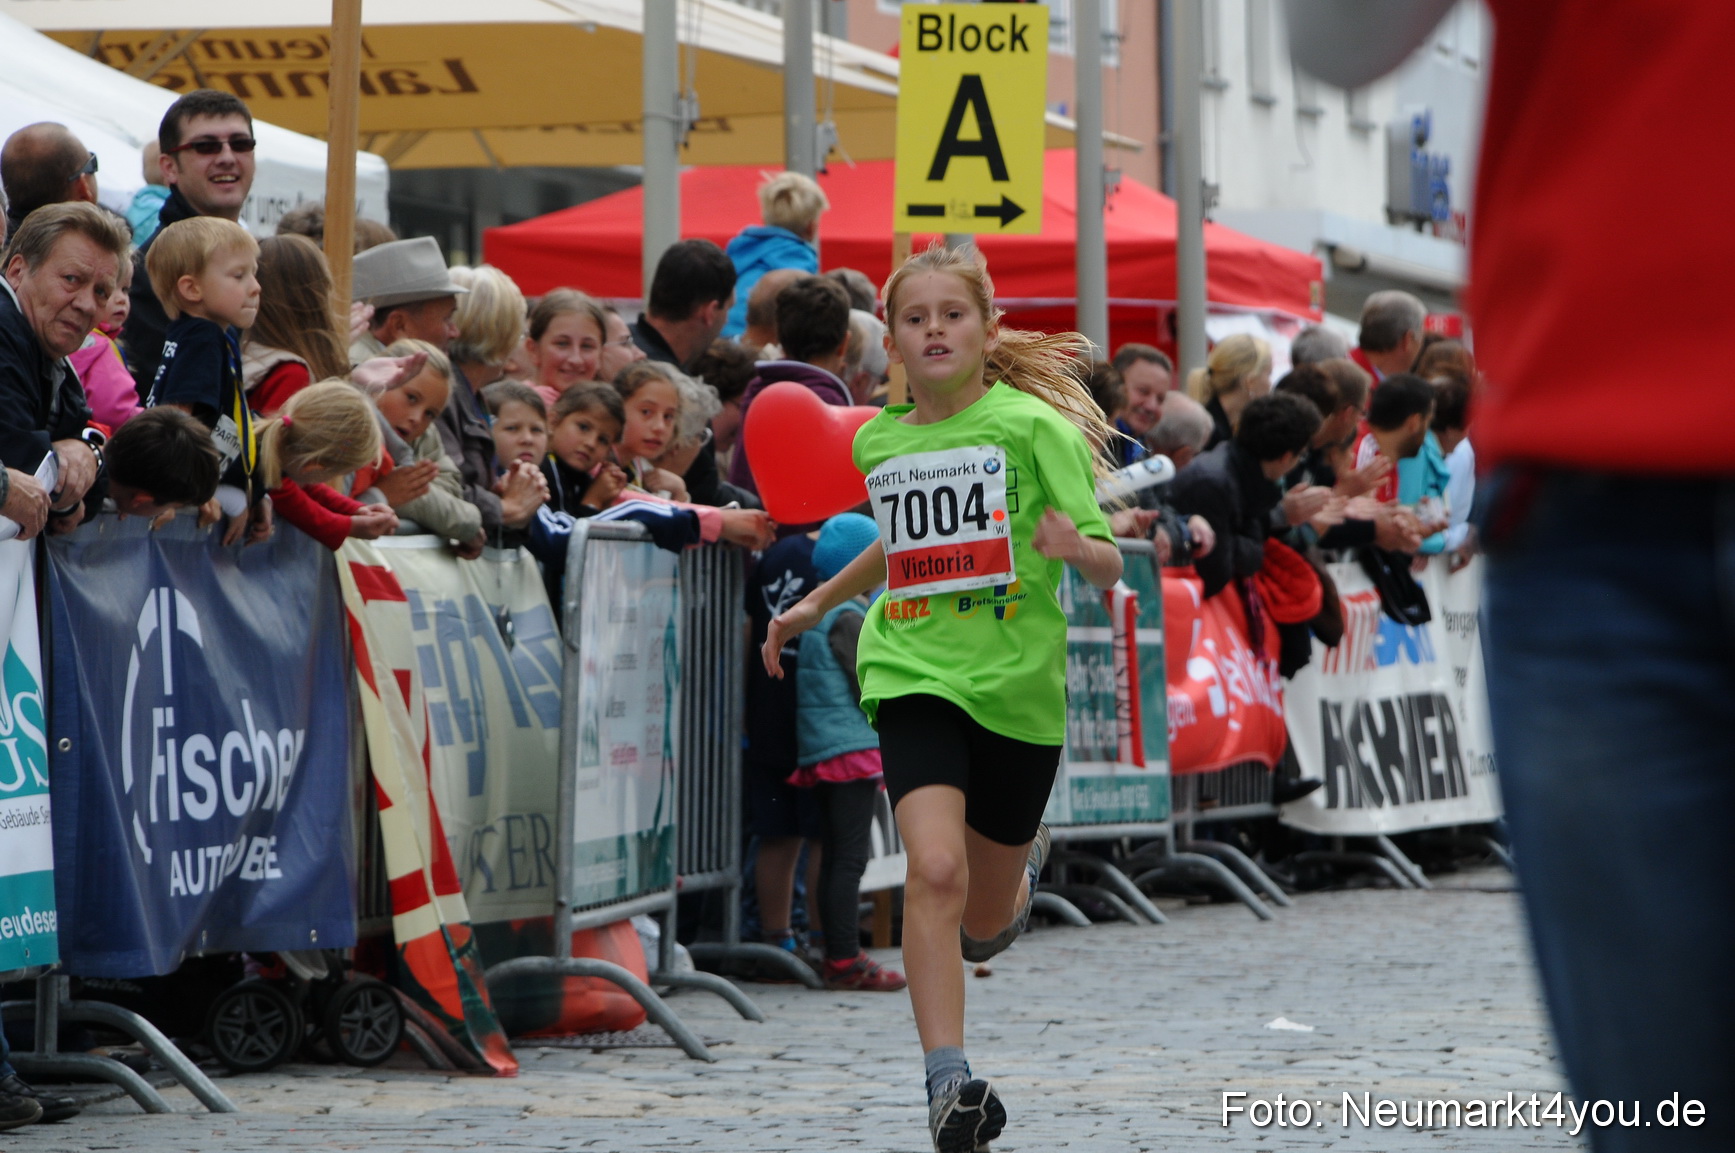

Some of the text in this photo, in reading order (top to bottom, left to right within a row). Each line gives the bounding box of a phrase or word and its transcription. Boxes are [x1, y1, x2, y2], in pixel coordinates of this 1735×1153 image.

[917, 13, 1030, 52] Block
[926, 74, 1010, 181] A
[867, 462, 978, 490] PARTL Neumarkt
[880, 482, 990, 544] 7004
[901, 551, 975, 580] Victoria
[149, 699, 306, 823] Fischer
[0, 805, 41, 830] Gebäude
